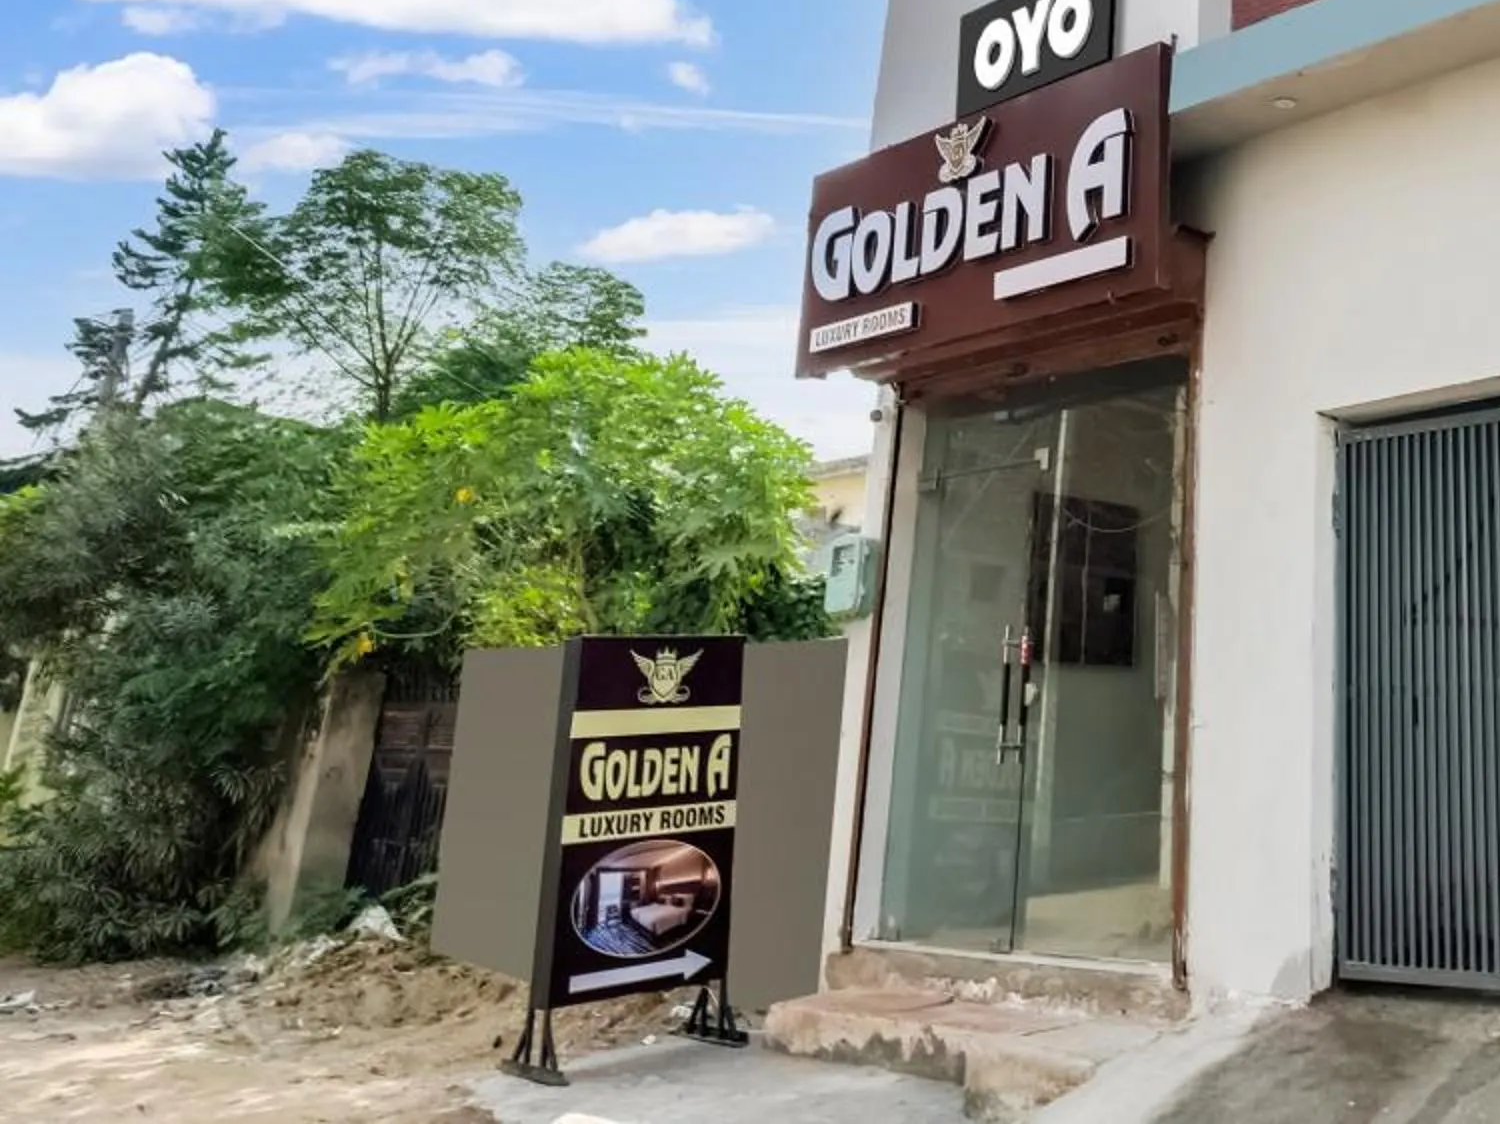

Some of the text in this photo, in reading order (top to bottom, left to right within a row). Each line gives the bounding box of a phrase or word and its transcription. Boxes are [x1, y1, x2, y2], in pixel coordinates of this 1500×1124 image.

[812, 107, 1134, 301] GOLDEN A
[816, 308, 906, 347] LUXURY ROOMS
[580, 733, 732, 801] GOLDEN A
[578, 805, 726, 838] LUXURY ROOMS
